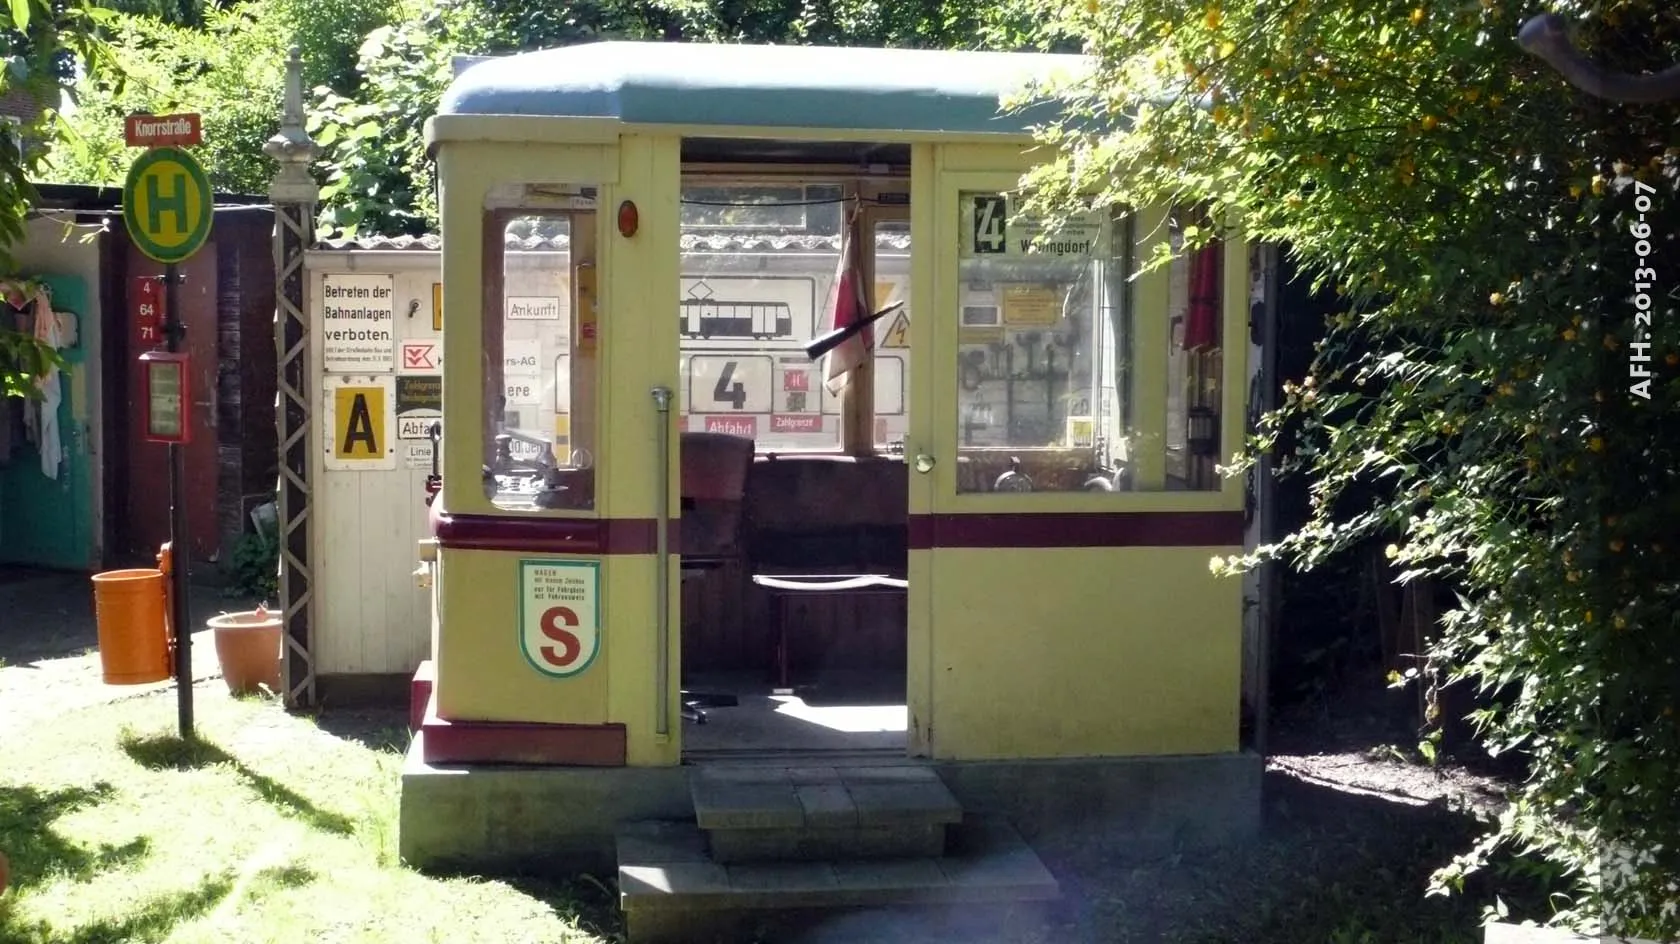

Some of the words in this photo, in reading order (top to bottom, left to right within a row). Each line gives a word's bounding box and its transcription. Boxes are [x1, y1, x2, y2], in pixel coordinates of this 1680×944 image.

[134, 117, 192, 137] Knorrstraße
[145, 174, 188, 234] H
[976, 200, 1004, 250] 4
[143, 281, 150, 293] 4
[325, 285, 369, 298] Betreten
[372, 285, 392, 298] der
[140, 303, 153, 316] 64
[325, 306, 392, 322] Bahnanlagen
[510, 303, 557, 316] Ankunft
[141, 326, 153, 338] 71
[713, 361, 747, 410] 4
[342, 392, 377, 454] A
[402, 421, 431, 435] Abfa
[709, 421, 752, 435] Abfahrt
[410, 447, 432, 457] Linie
[539, 605, 581, 667] S
